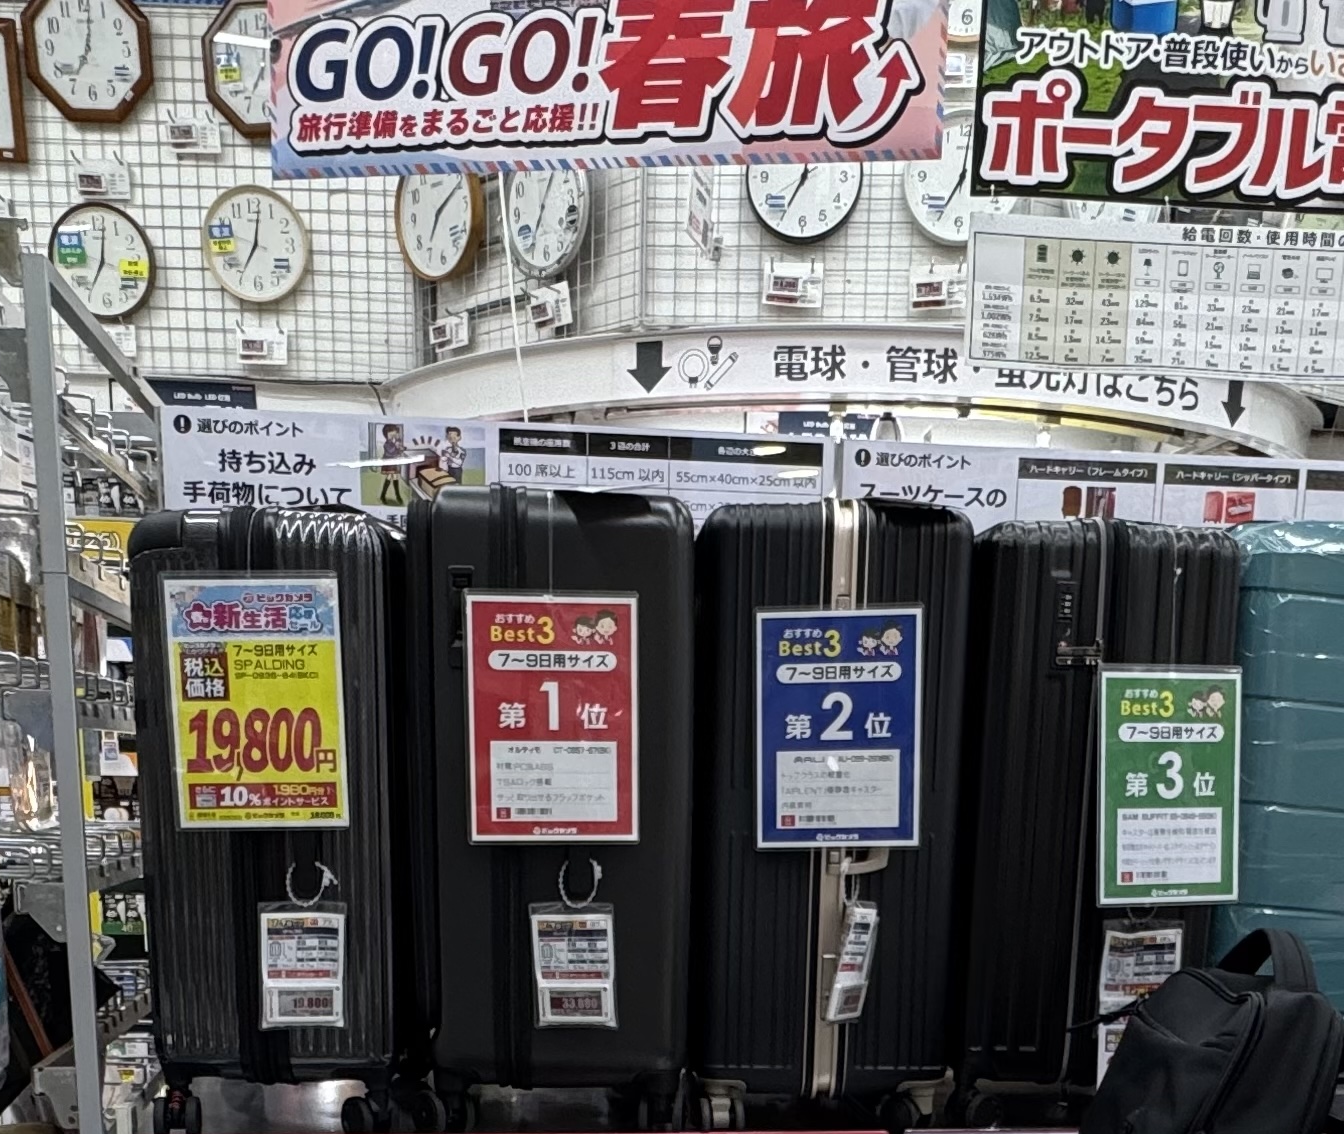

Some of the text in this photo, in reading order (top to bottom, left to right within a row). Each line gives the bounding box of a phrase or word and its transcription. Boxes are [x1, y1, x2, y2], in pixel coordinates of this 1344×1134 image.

[197, 419, 304, 438] 選びのポイント
[218, 449, 316, 475] 持ち込み
[507, 464, 532, 477] 100
[875, 451, 972, 471] 選びのポイント
[591, 467, 634, 481] 115cm
[183, 481, 352, 505] 手荷物について
[213, 602, 287, 630] 新生活
[490, 616, 555, 644] Best3
[778, 629, 841, 657] Best3
[184, 658, 224, 676] 税込
[185, 679, 225, 697] 価格
[1120, 691, 1174, 717] Best3
[186, 707, 337, 781] 19,800円
[220, 786, 261, 806] 10%
